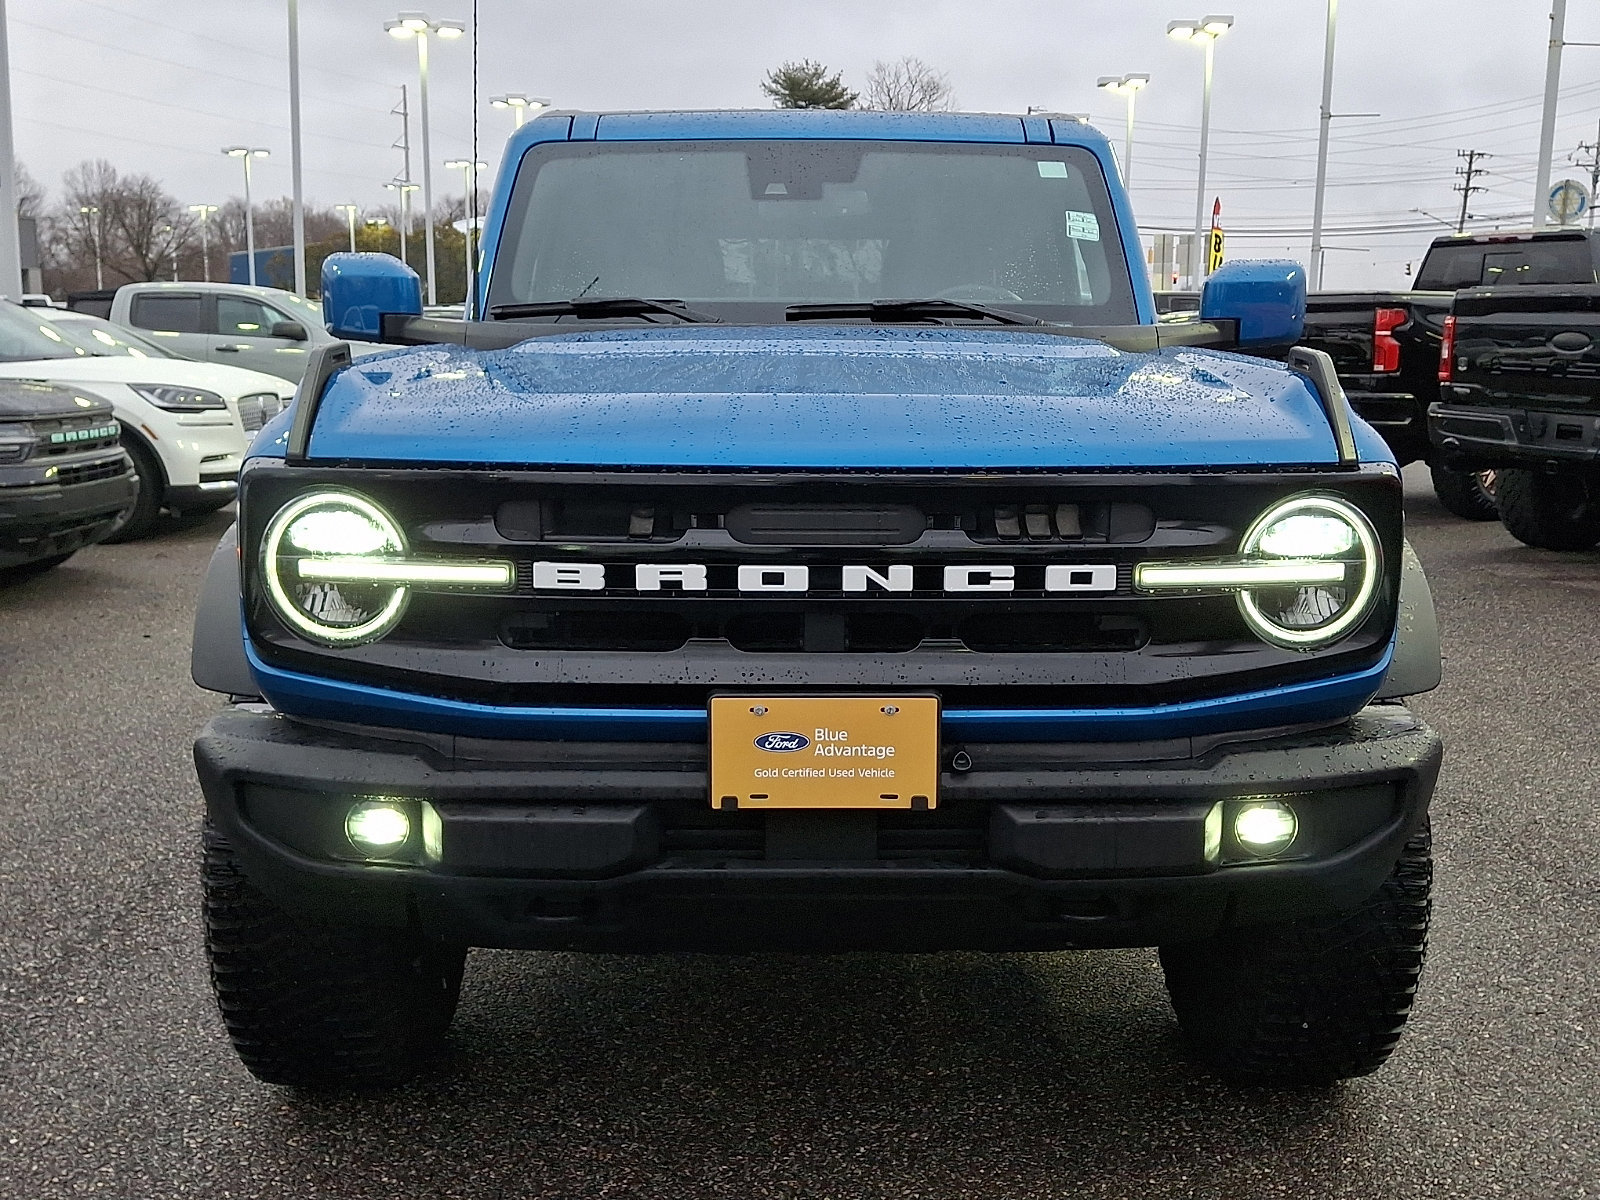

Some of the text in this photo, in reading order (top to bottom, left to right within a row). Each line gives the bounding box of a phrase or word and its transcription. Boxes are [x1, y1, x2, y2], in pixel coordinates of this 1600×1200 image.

[533, 561, 1117, 592] BRONCO
[764, 734, 799, 749] Ford
[814, 728, 848, 741] Blue
[814, 743, 896, 759] Advantage
[754, 768, 895, 778] Gold Certified Used Vehicle
